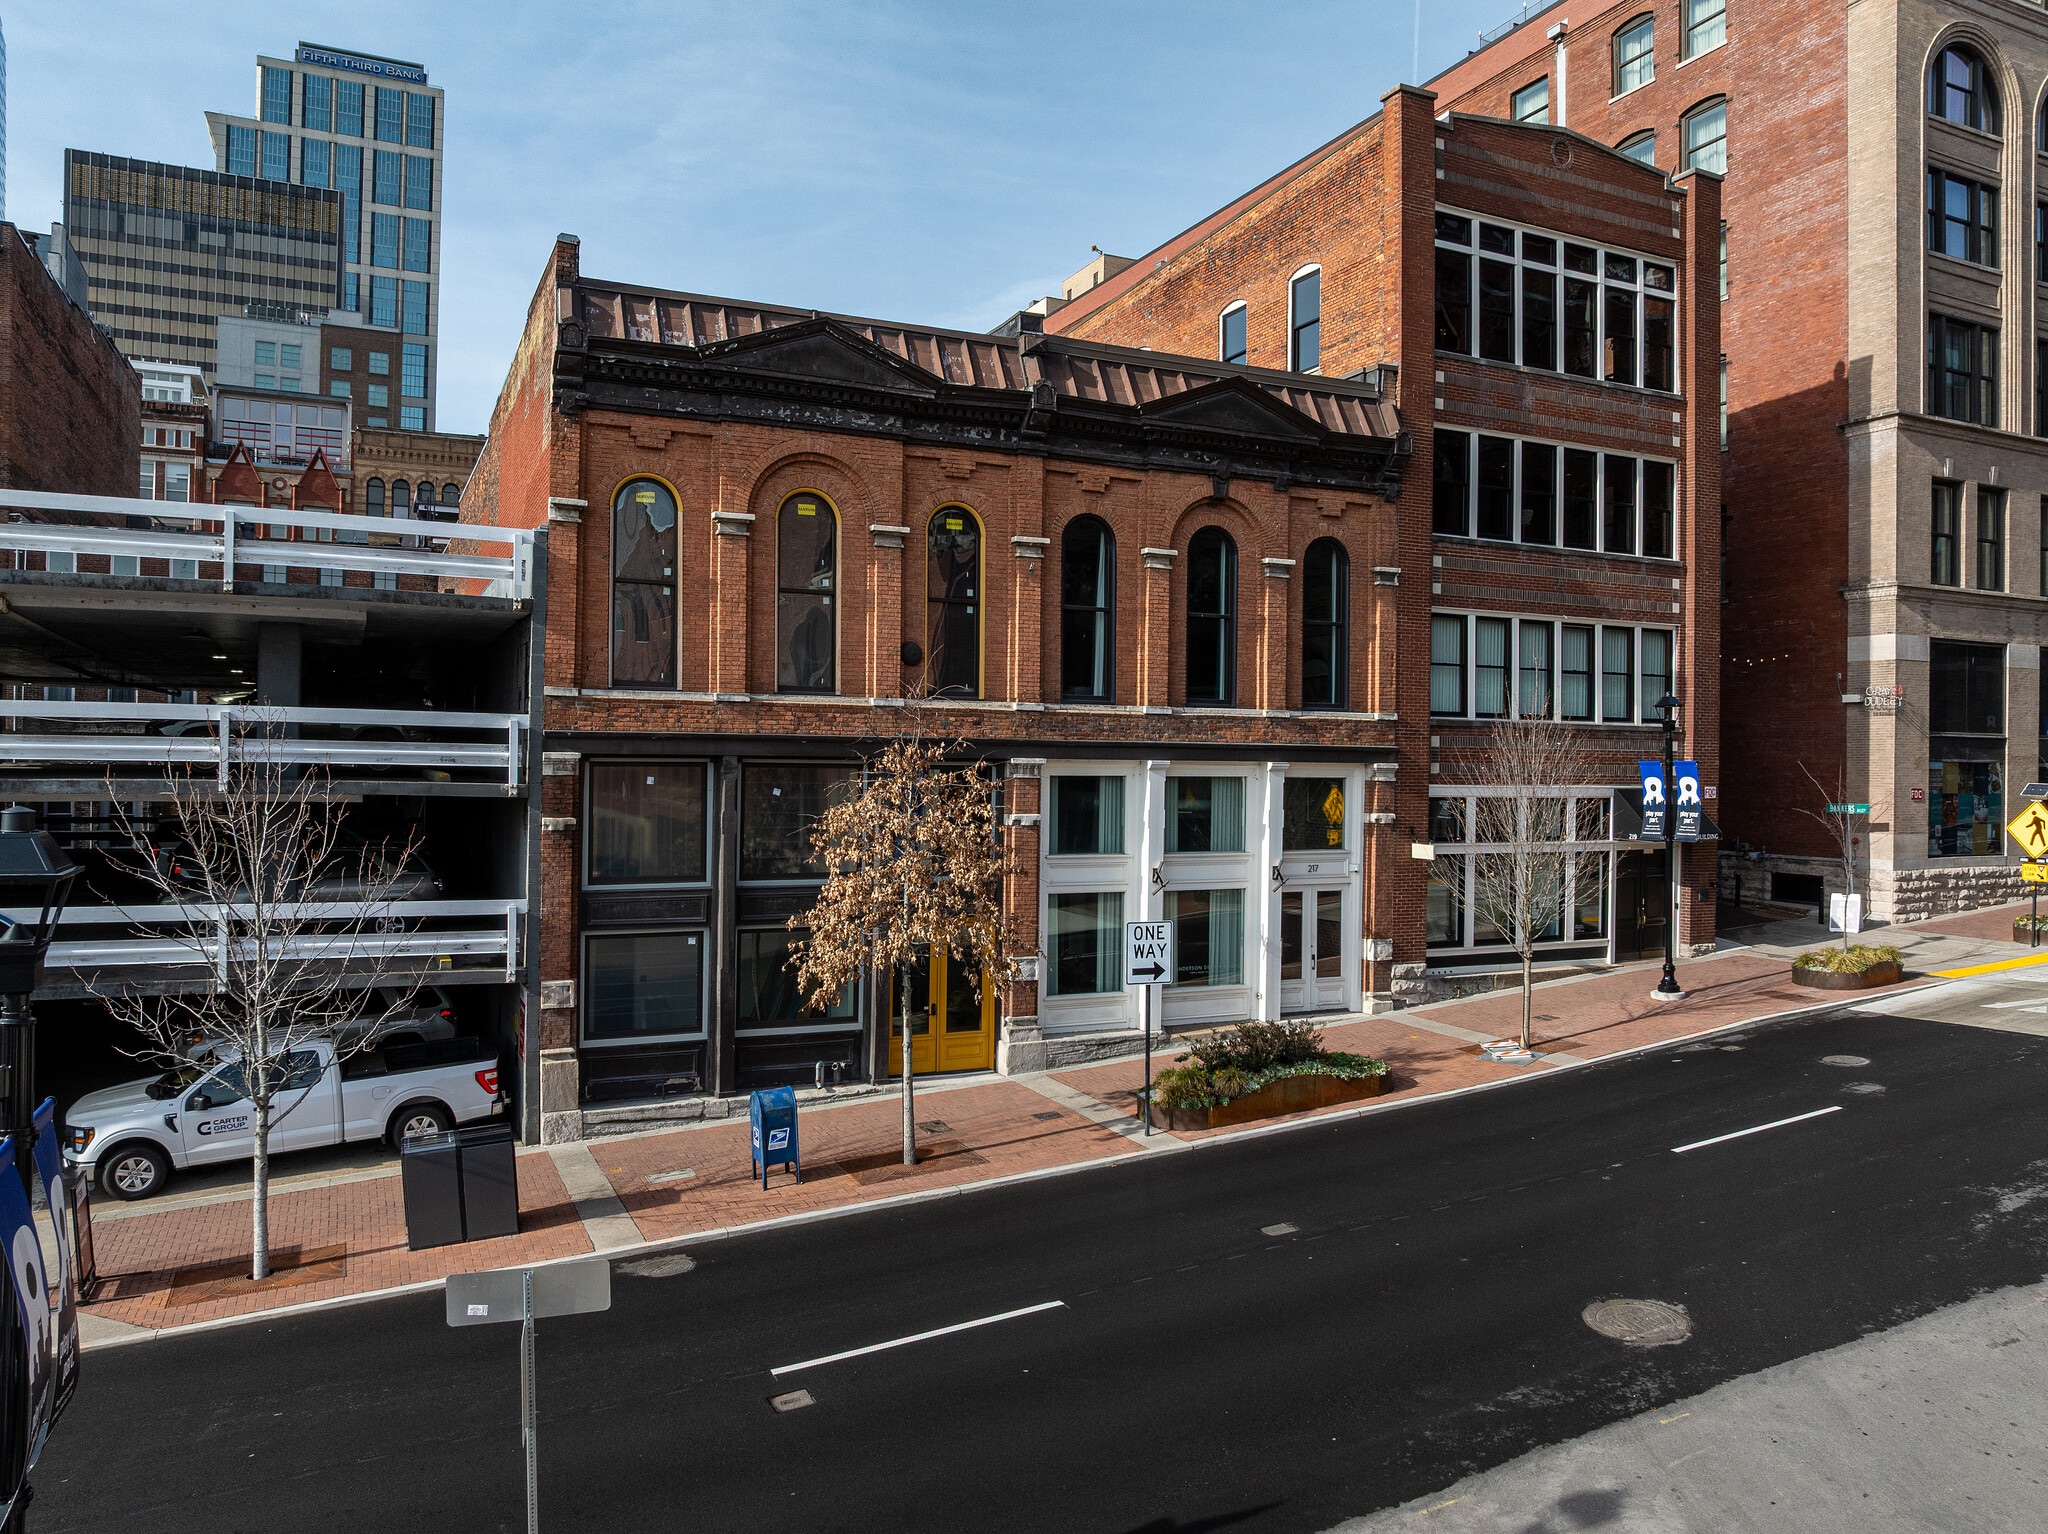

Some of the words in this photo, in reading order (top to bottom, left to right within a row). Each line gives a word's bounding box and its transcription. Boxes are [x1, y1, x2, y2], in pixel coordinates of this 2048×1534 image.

[303, 50, 337, 64] FIFTH
[343, 58, 381, 73] THIRD
[386, 66, 420, 80] BANK
[1911, 790, 1923, 799] FDC
[1829, 804, 1855, 813] BANKERS
[1307, 864, 1319, 873] 217
[1133, 925, 1165, 941] ONE
[1133, 943, 1168, 959] WAY
[213, 1116, 248, 1125] CARTER
[213, 1122, 246, 1132] GROUP
